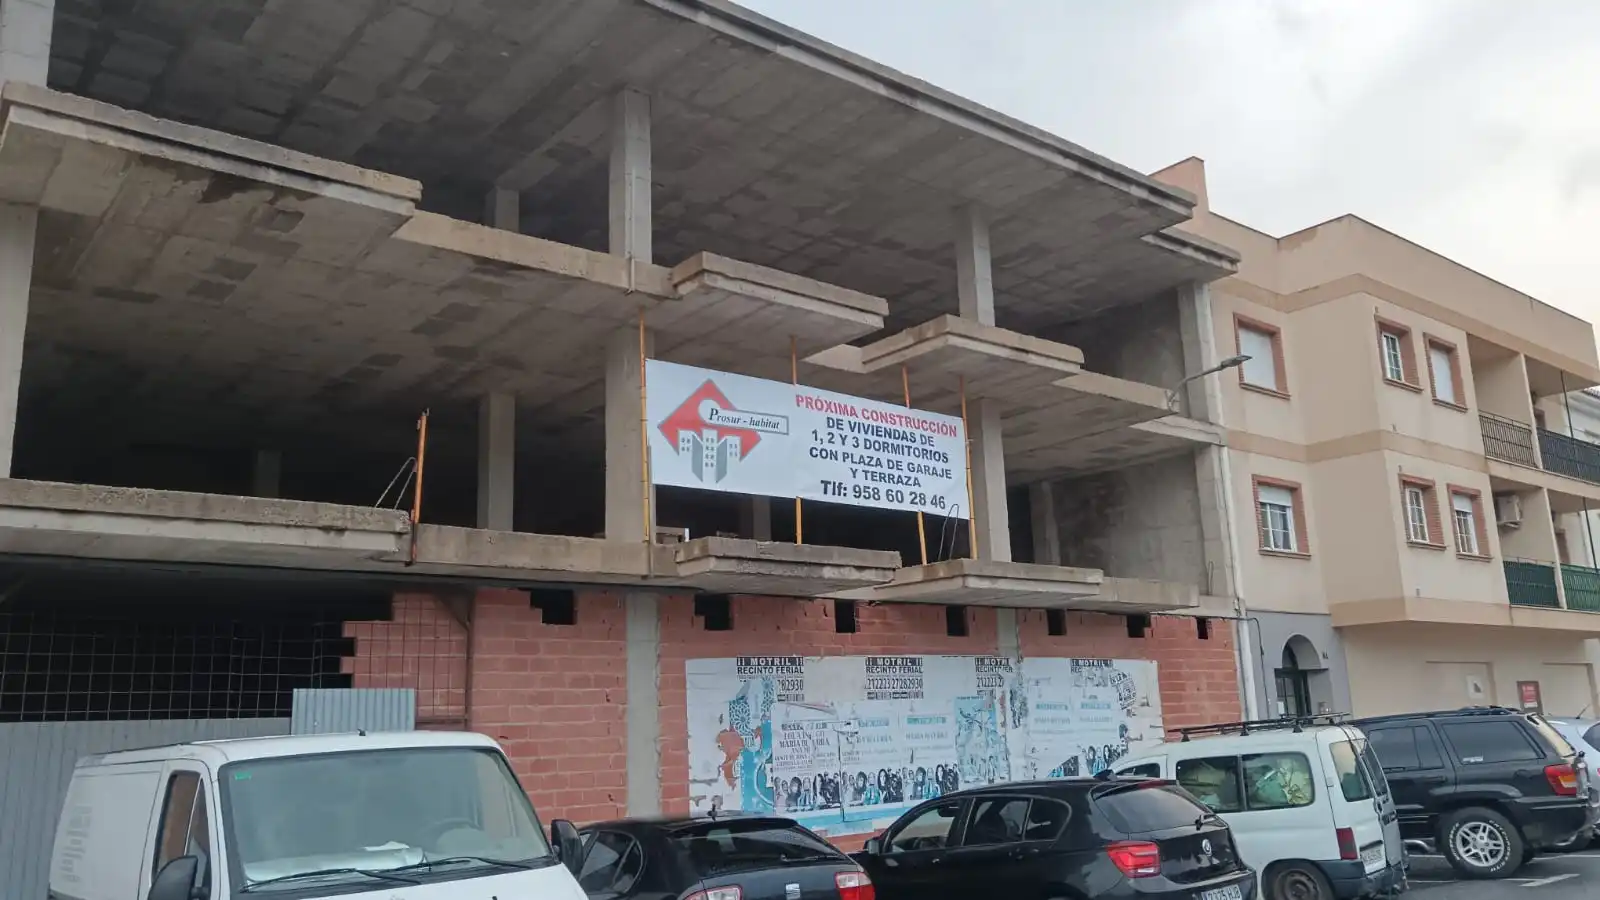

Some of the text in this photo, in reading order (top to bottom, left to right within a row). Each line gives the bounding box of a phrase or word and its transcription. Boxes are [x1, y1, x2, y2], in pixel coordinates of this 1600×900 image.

[709, 408, 741, 425] Prosur
[749, 416, 780, 429] habitat
[795, 394, 957, 437] PRÓXIMA CONSTRUCCIÓN
[826, 416, 935, 447] DE VIVIENDAS DE
[827, 432, 835, 444] 2
[839, 434, 848, 446] Y
[852, 436, 860, 449] 3
[863, 438, 949, 464] DORMITORIOS
[809, 446, 952, 480] CON PLAZA DE GARAJE
[849, 467, 922, 488] Y TERRAZA
[820, 480, 946, 510] Tlf: 958 60 28 46
[737, 666, 804, 675] RECINTO FERIAL
[750, 657, 791, 666] MOTRIL
[866, 666, 923, 674] RECINTO FERIAL
[876, 657, 912, 666] MOTRIL
